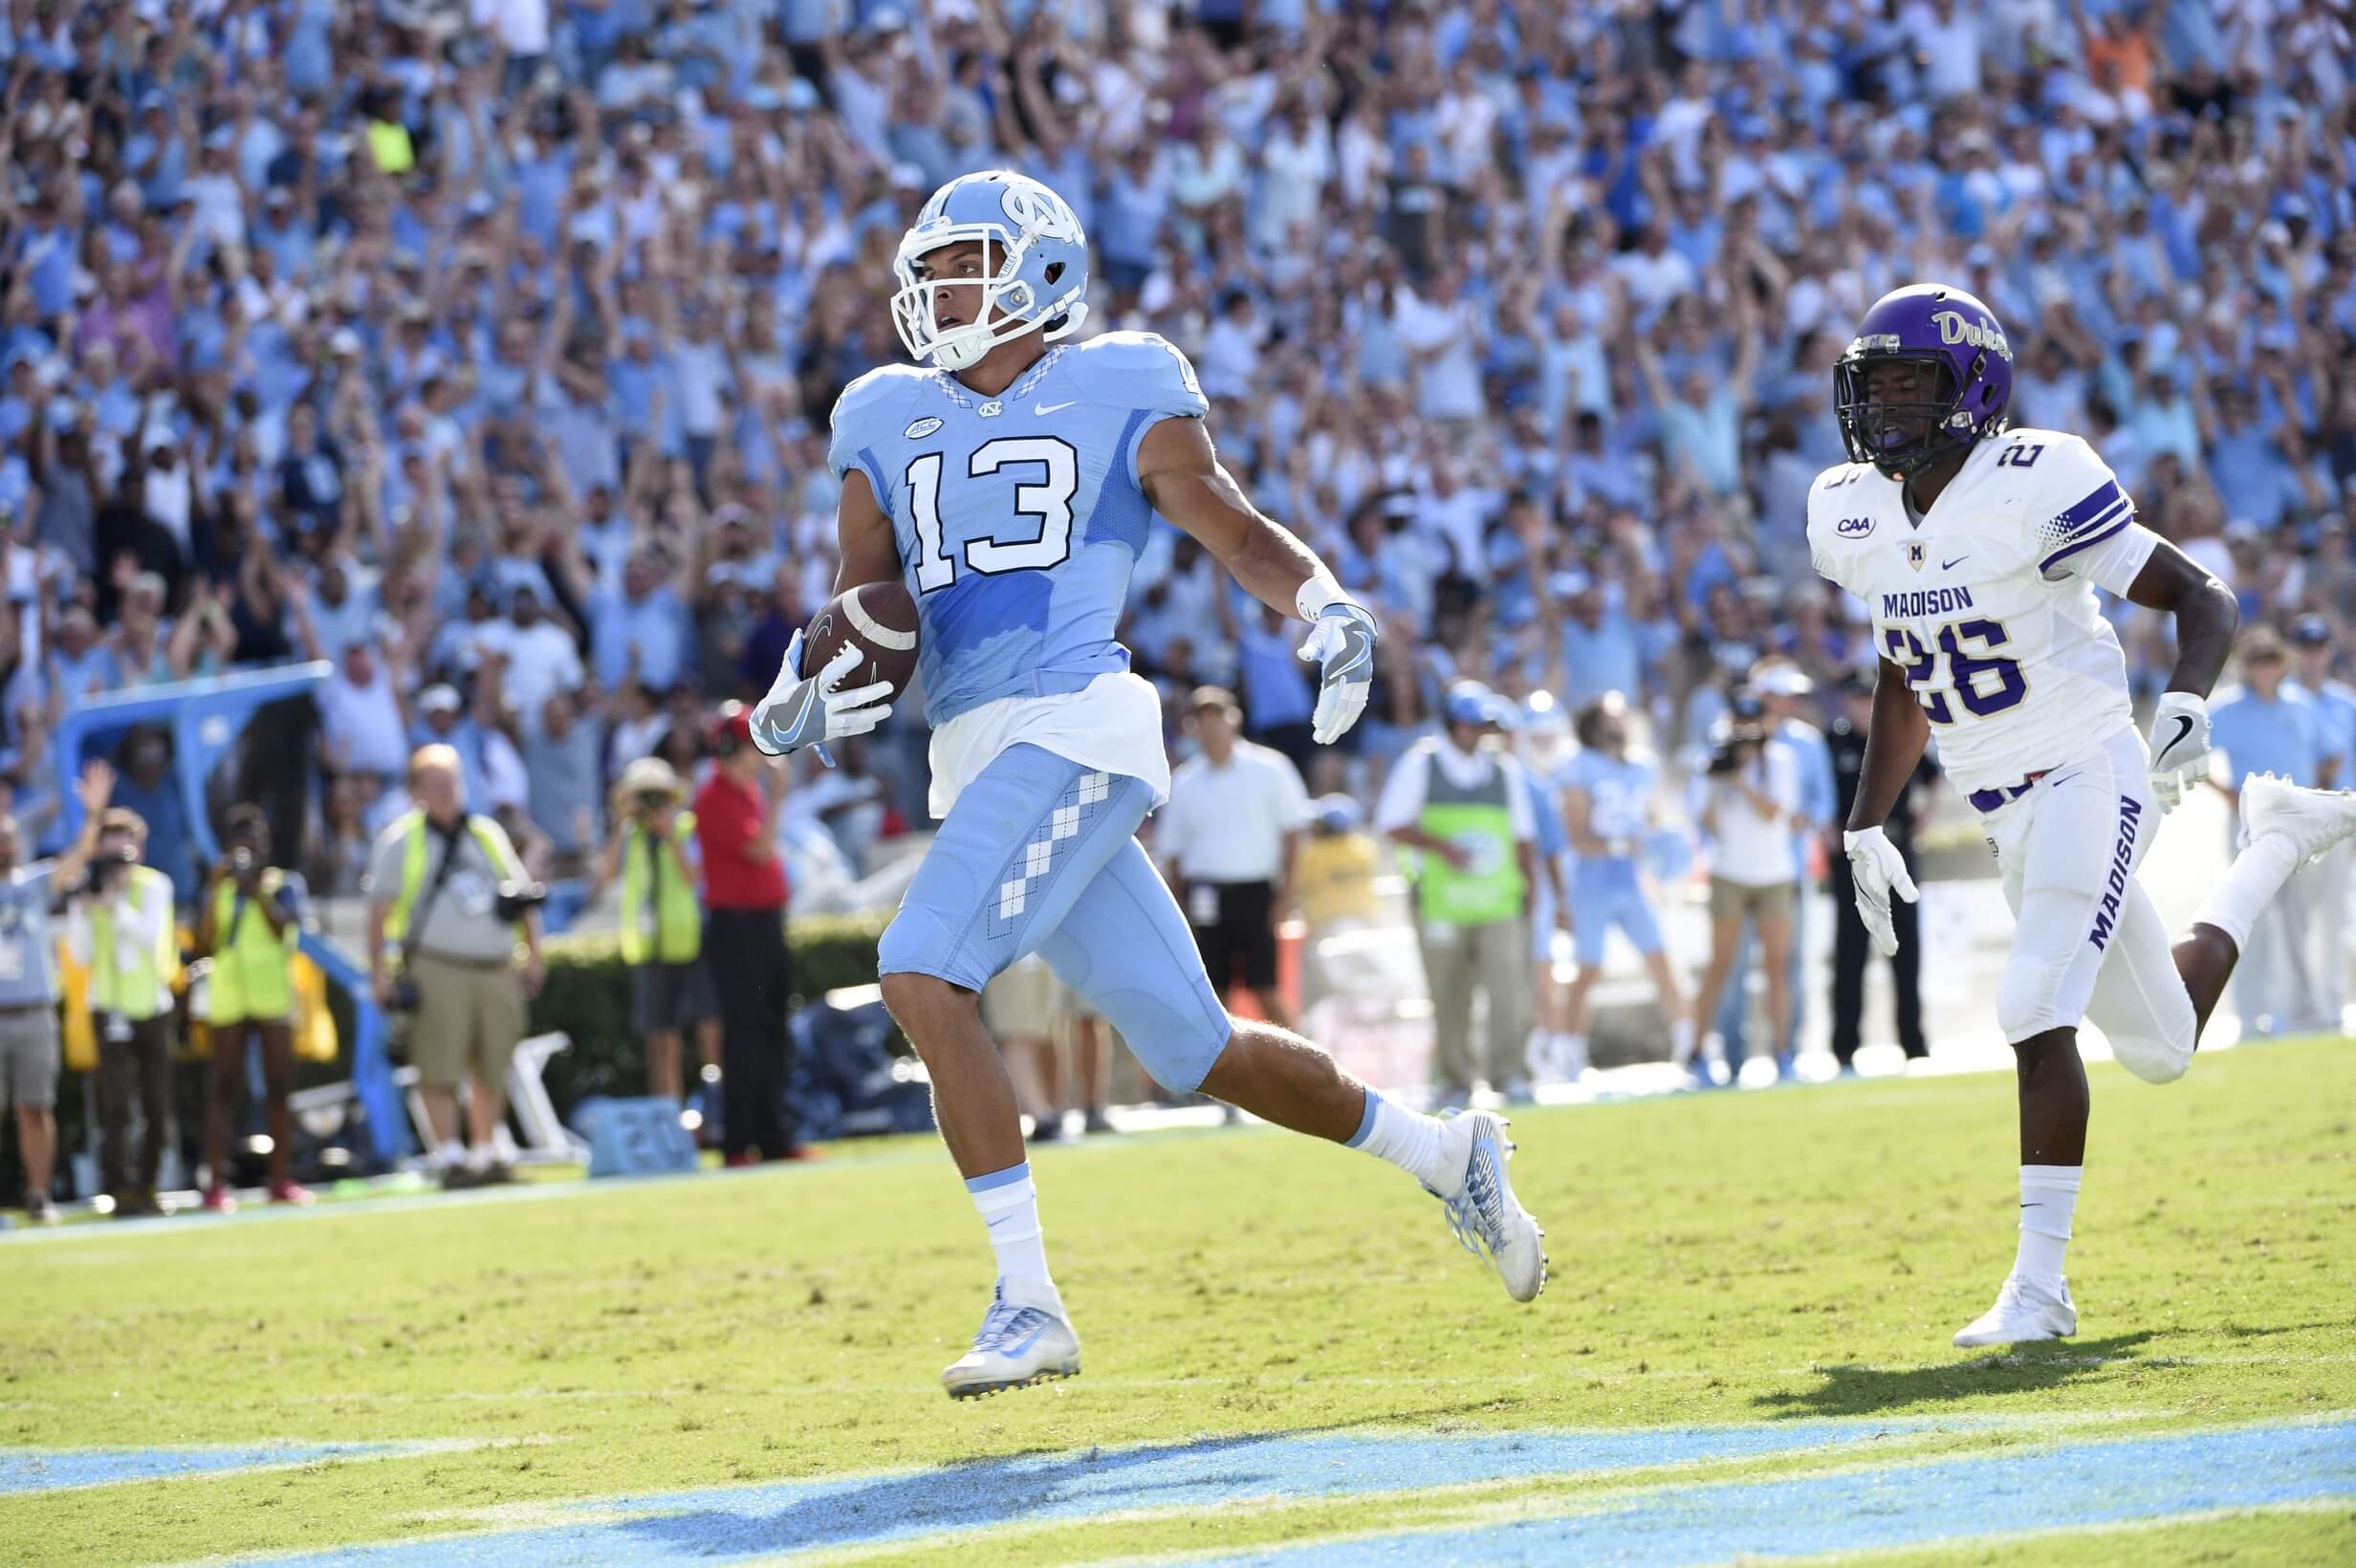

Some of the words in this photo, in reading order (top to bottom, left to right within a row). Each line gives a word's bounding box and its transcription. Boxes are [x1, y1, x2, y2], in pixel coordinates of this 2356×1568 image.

[905, 435, 1080, 597] 13
[1837, 517, 1870, 533] CAA
[1910, 545, 1923, 561] M
[1882, 586, 1974, 619] MADISON
[1883, 615, 2032, 727] 26
[2088, 795, 2143, 954] MADISON
